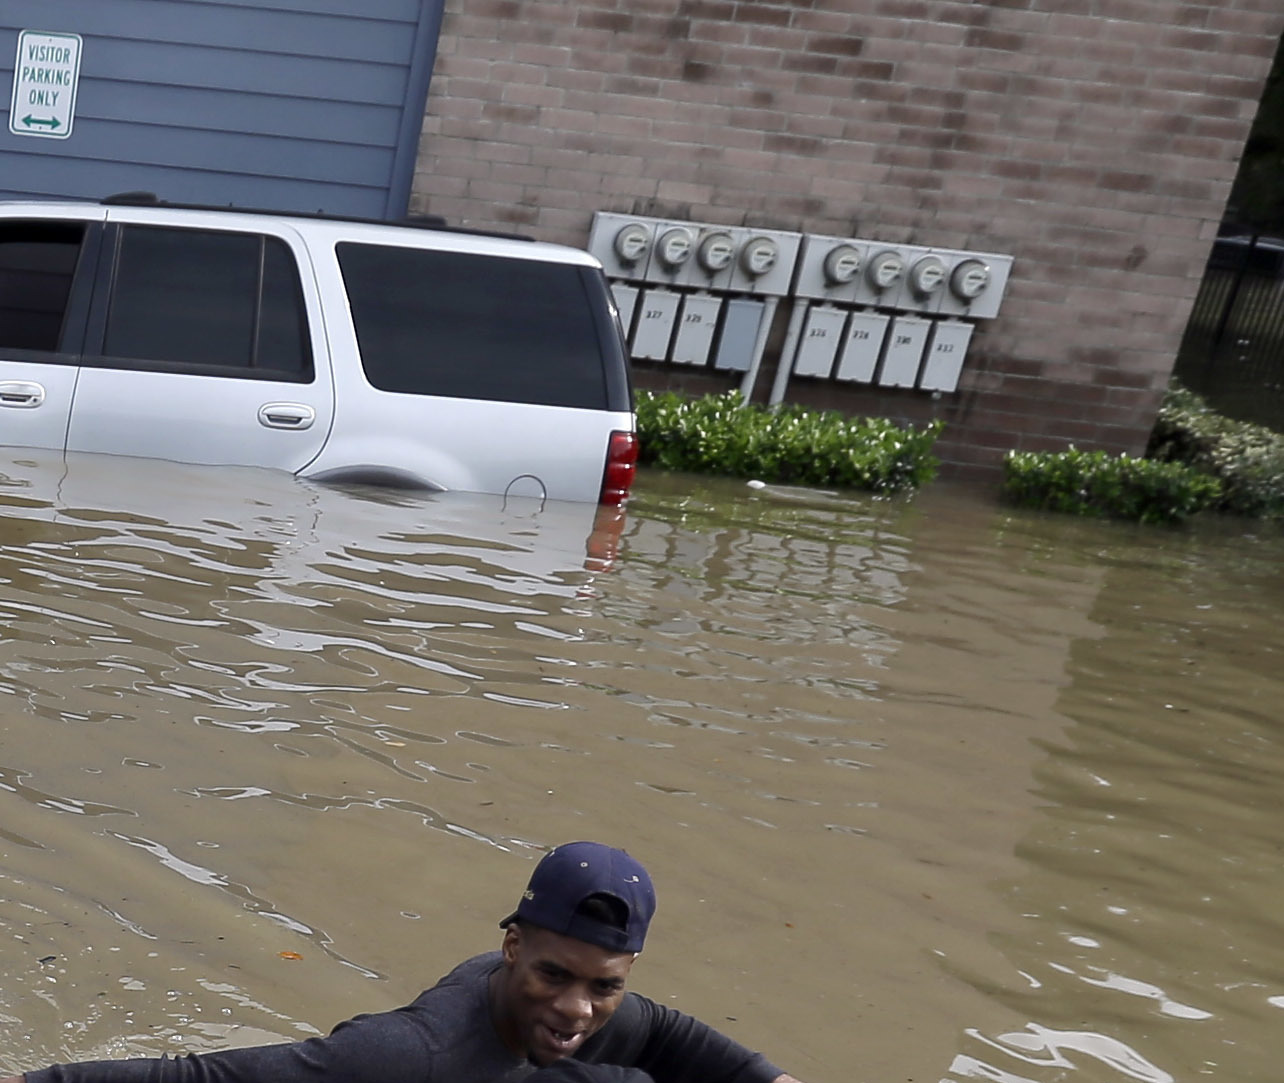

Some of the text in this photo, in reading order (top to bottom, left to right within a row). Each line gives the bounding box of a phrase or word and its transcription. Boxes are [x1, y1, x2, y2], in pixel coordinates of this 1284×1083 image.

[29, 44, 71, 63] VISITOR
[22, 66, 71, 86] PARKING
[29, 89, 59, 107] ONLY
